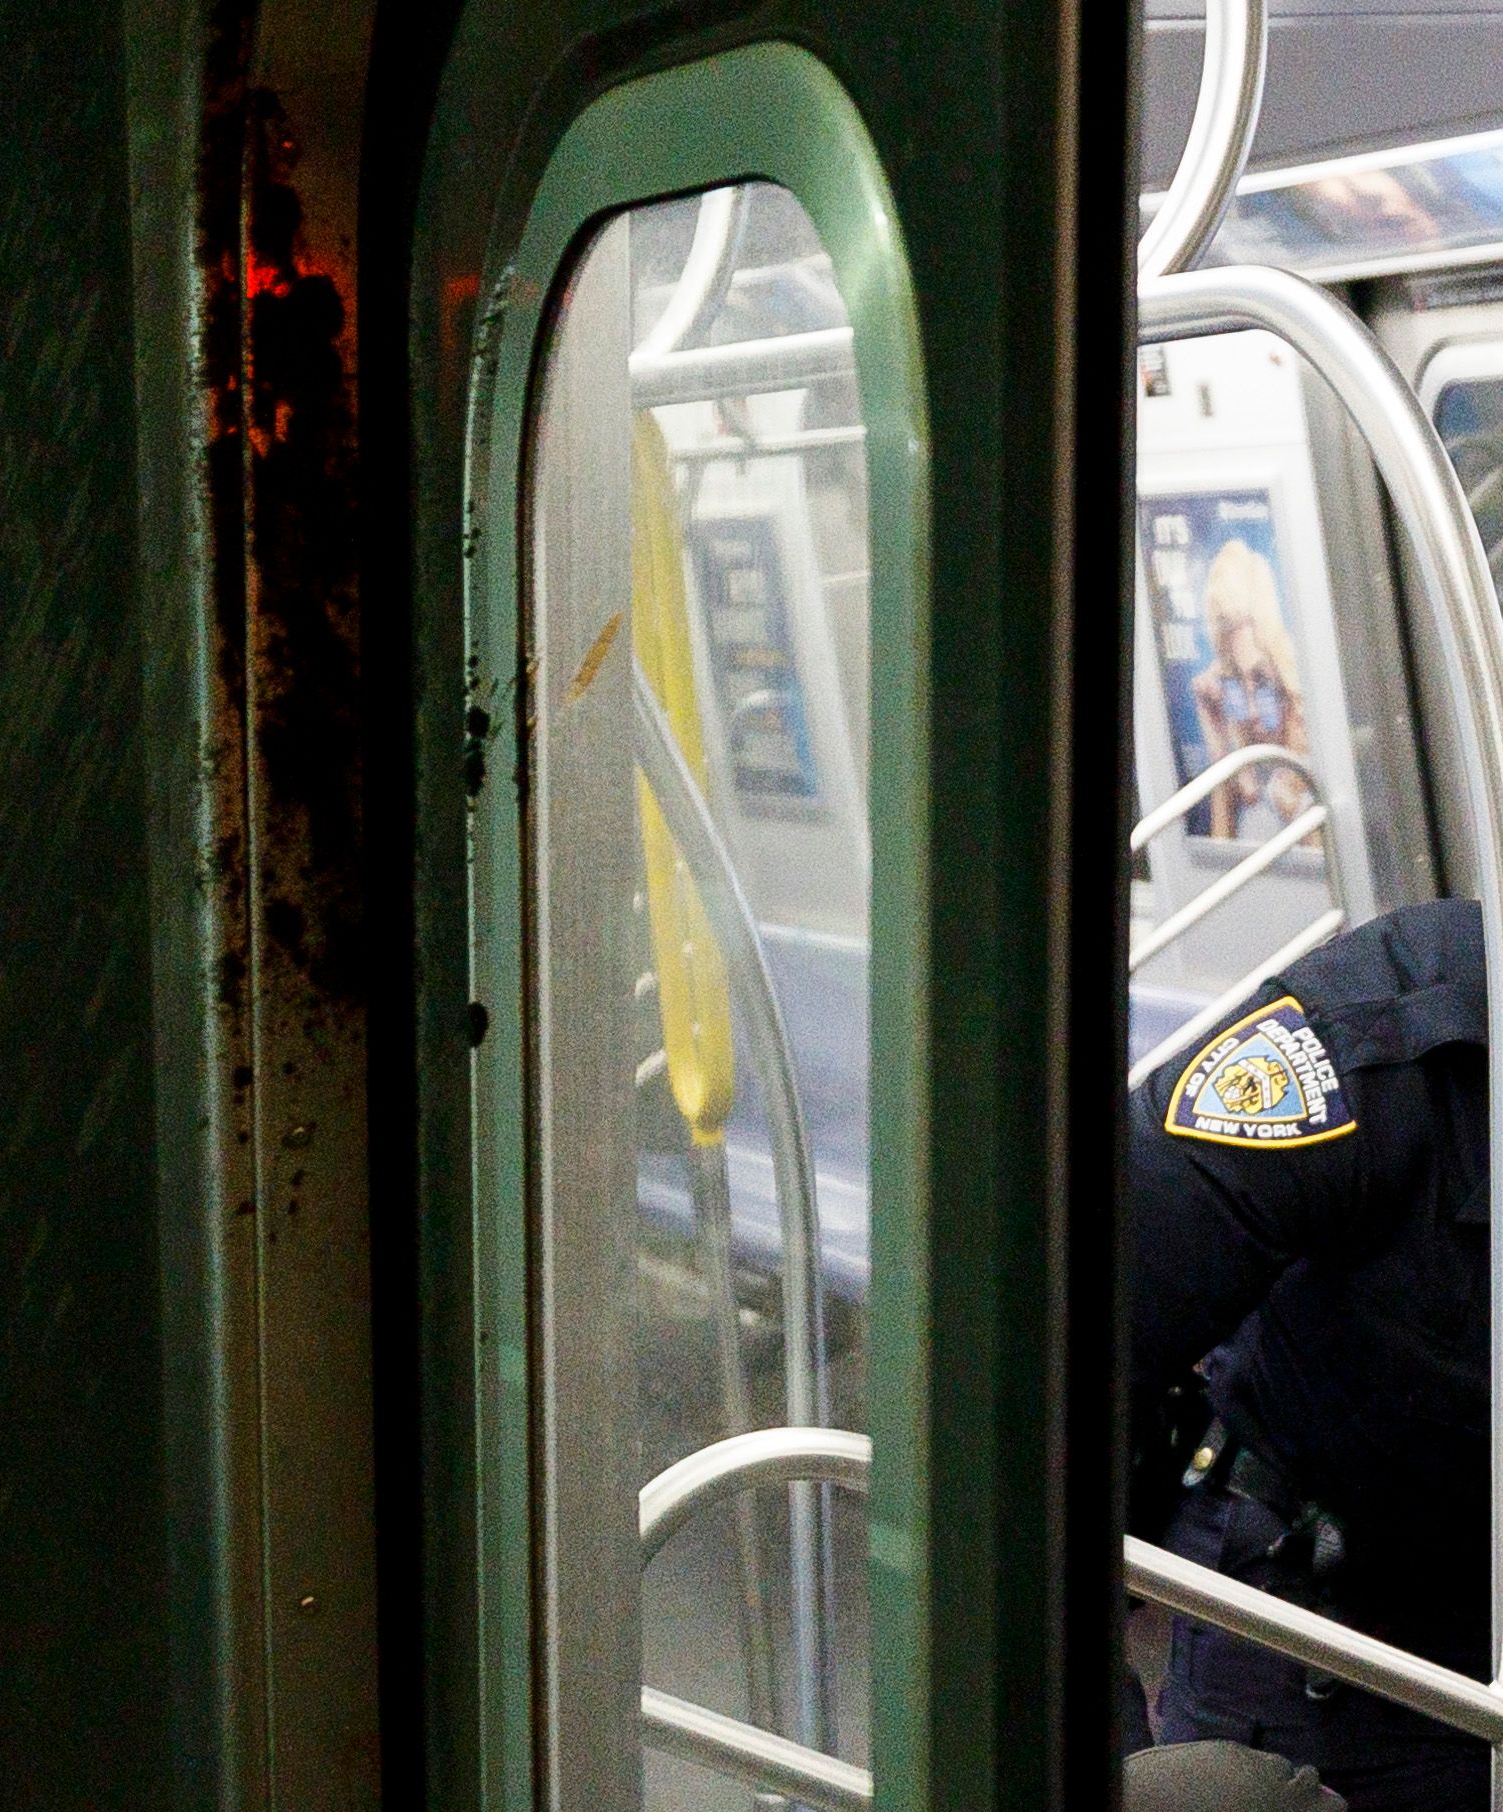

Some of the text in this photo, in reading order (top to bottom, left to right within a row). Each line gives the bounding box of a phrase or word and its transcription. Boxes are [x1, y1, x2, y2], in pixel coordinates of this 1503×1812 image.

[1185, 1037, 1240, 1098] CITY OF
[1256, 1018, 1327, 1125] DEPARTMENT
[1292, 1026, 1339, 1093] POLICE
[1195, 1116, 1302, 1138] NEW YORK
